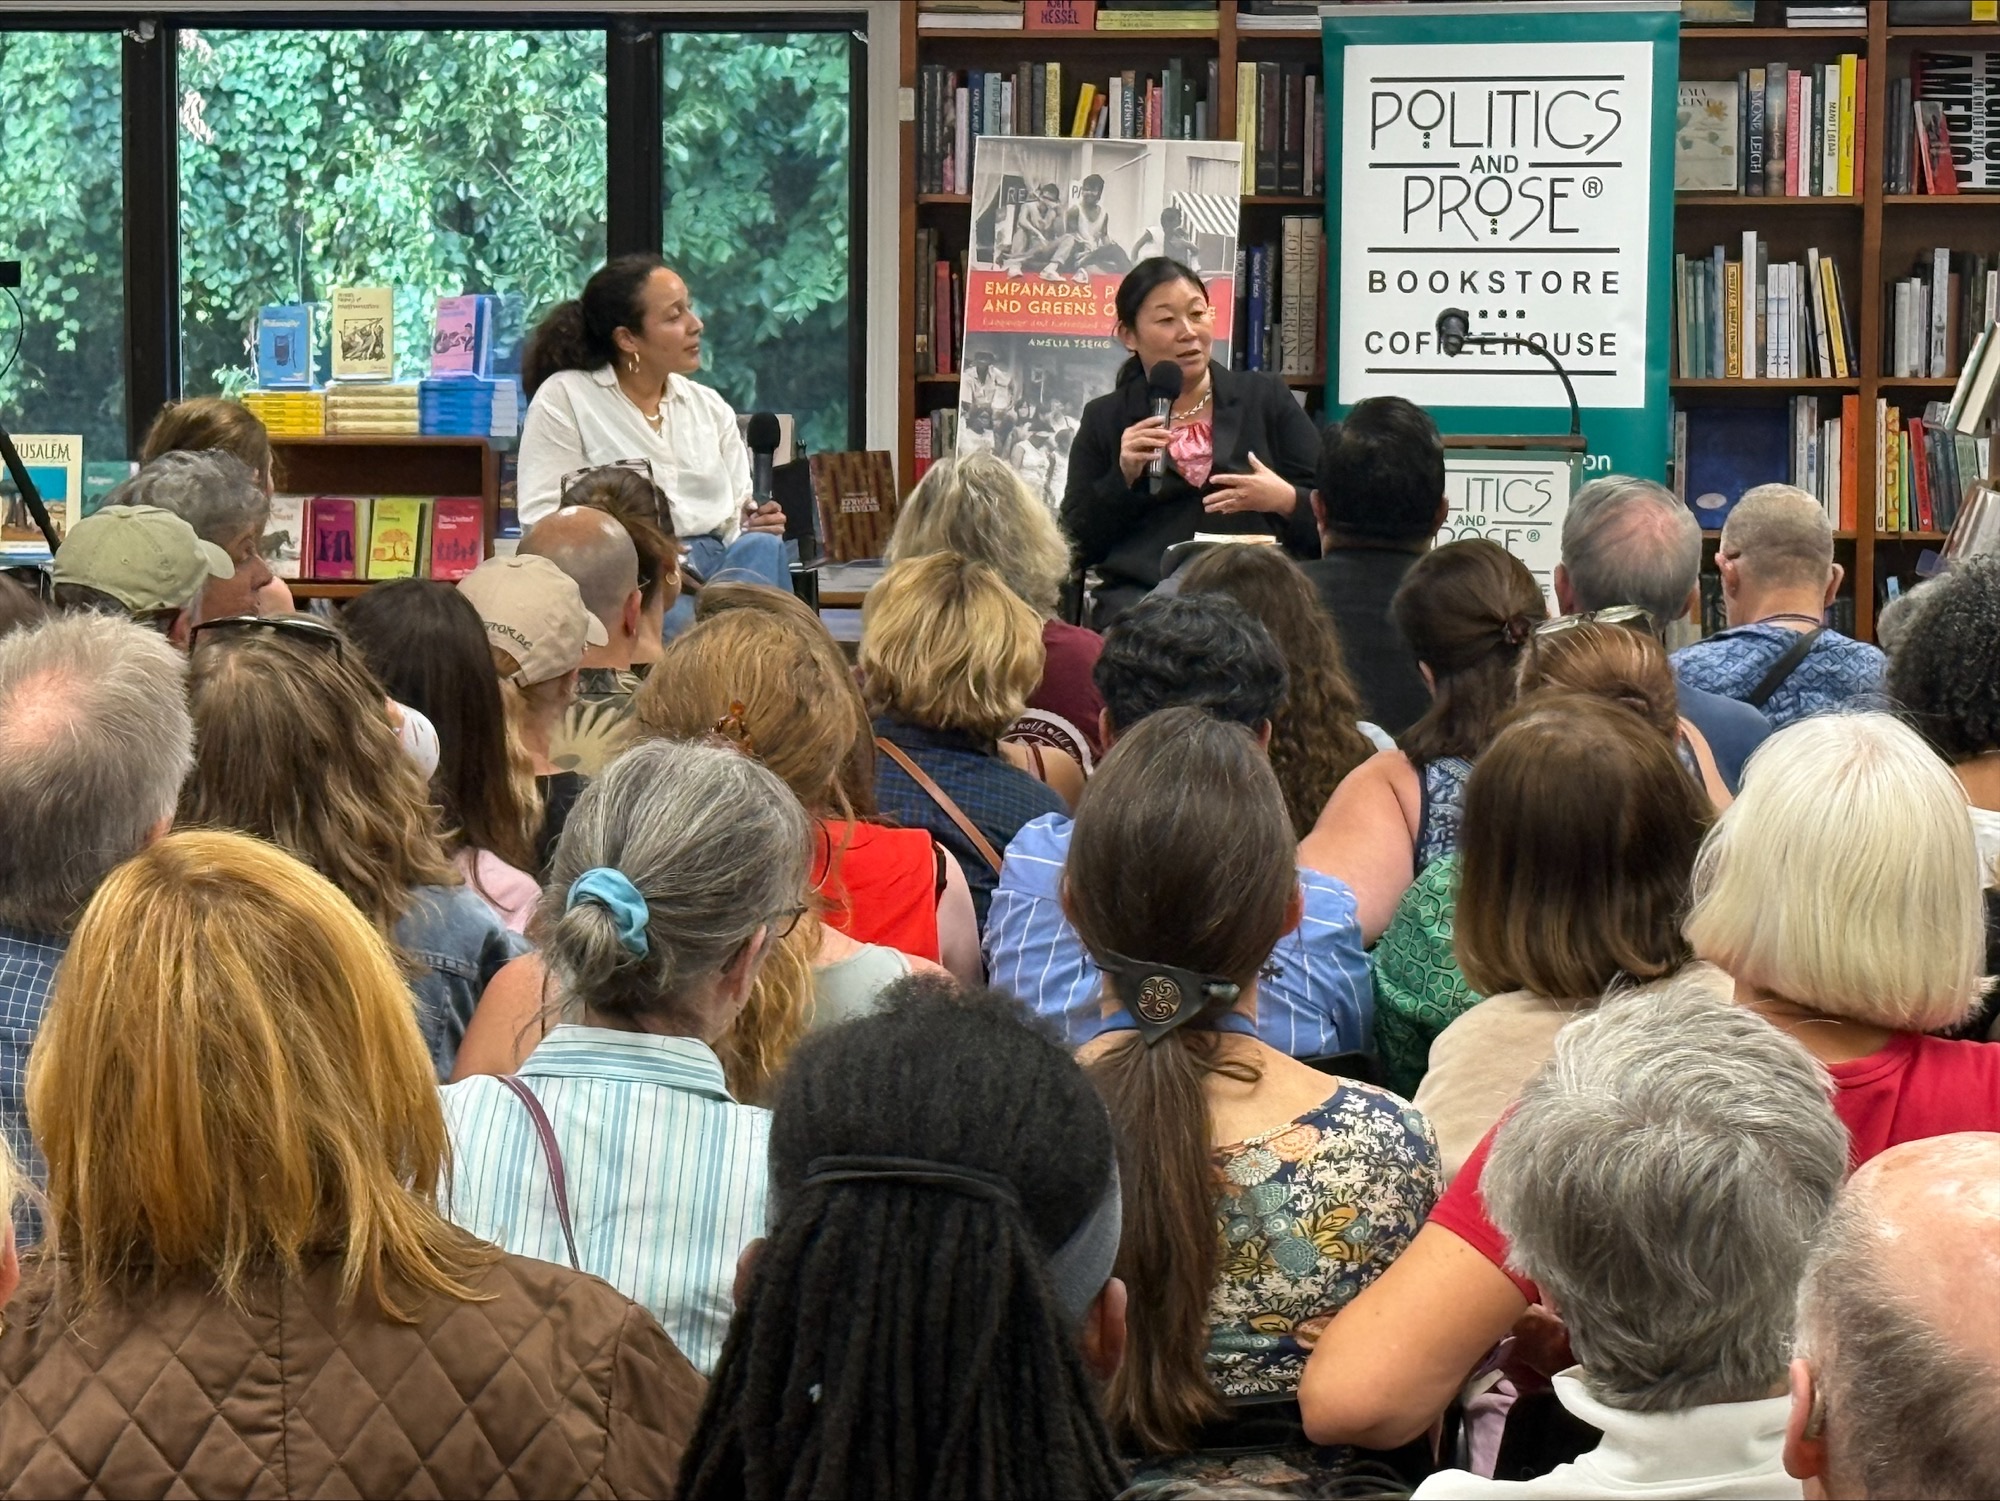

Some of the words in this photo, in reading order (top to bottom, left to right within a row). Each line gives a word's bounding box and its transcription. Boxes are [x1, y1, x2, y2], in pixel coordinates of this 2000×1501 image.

[1371, 88, 1621, 155] POLITICS
[1973, 95, 1985, 127] UNITED
[1469, 154, 1519, 174] AND
[1750, 135, 1763, 173] LEIGH
[1285, 231, 1298, 274] JOHN
[1303, 231, 1318, 274] JOHN
[984, 281, 1098, 299] EMPANADAS,
[1368, 269, 1620, 294] BOOKSTORE
[982, 299, 1022, 314] AND
[1028, 301, 1097, 316] GREENS
[1103, 302, 1117, 317] O
[1028, 338, 1070, 348] AMELIA
[1073, 339, 1112, 349] TSENG
[1454, 514, 1487, 527] AND
